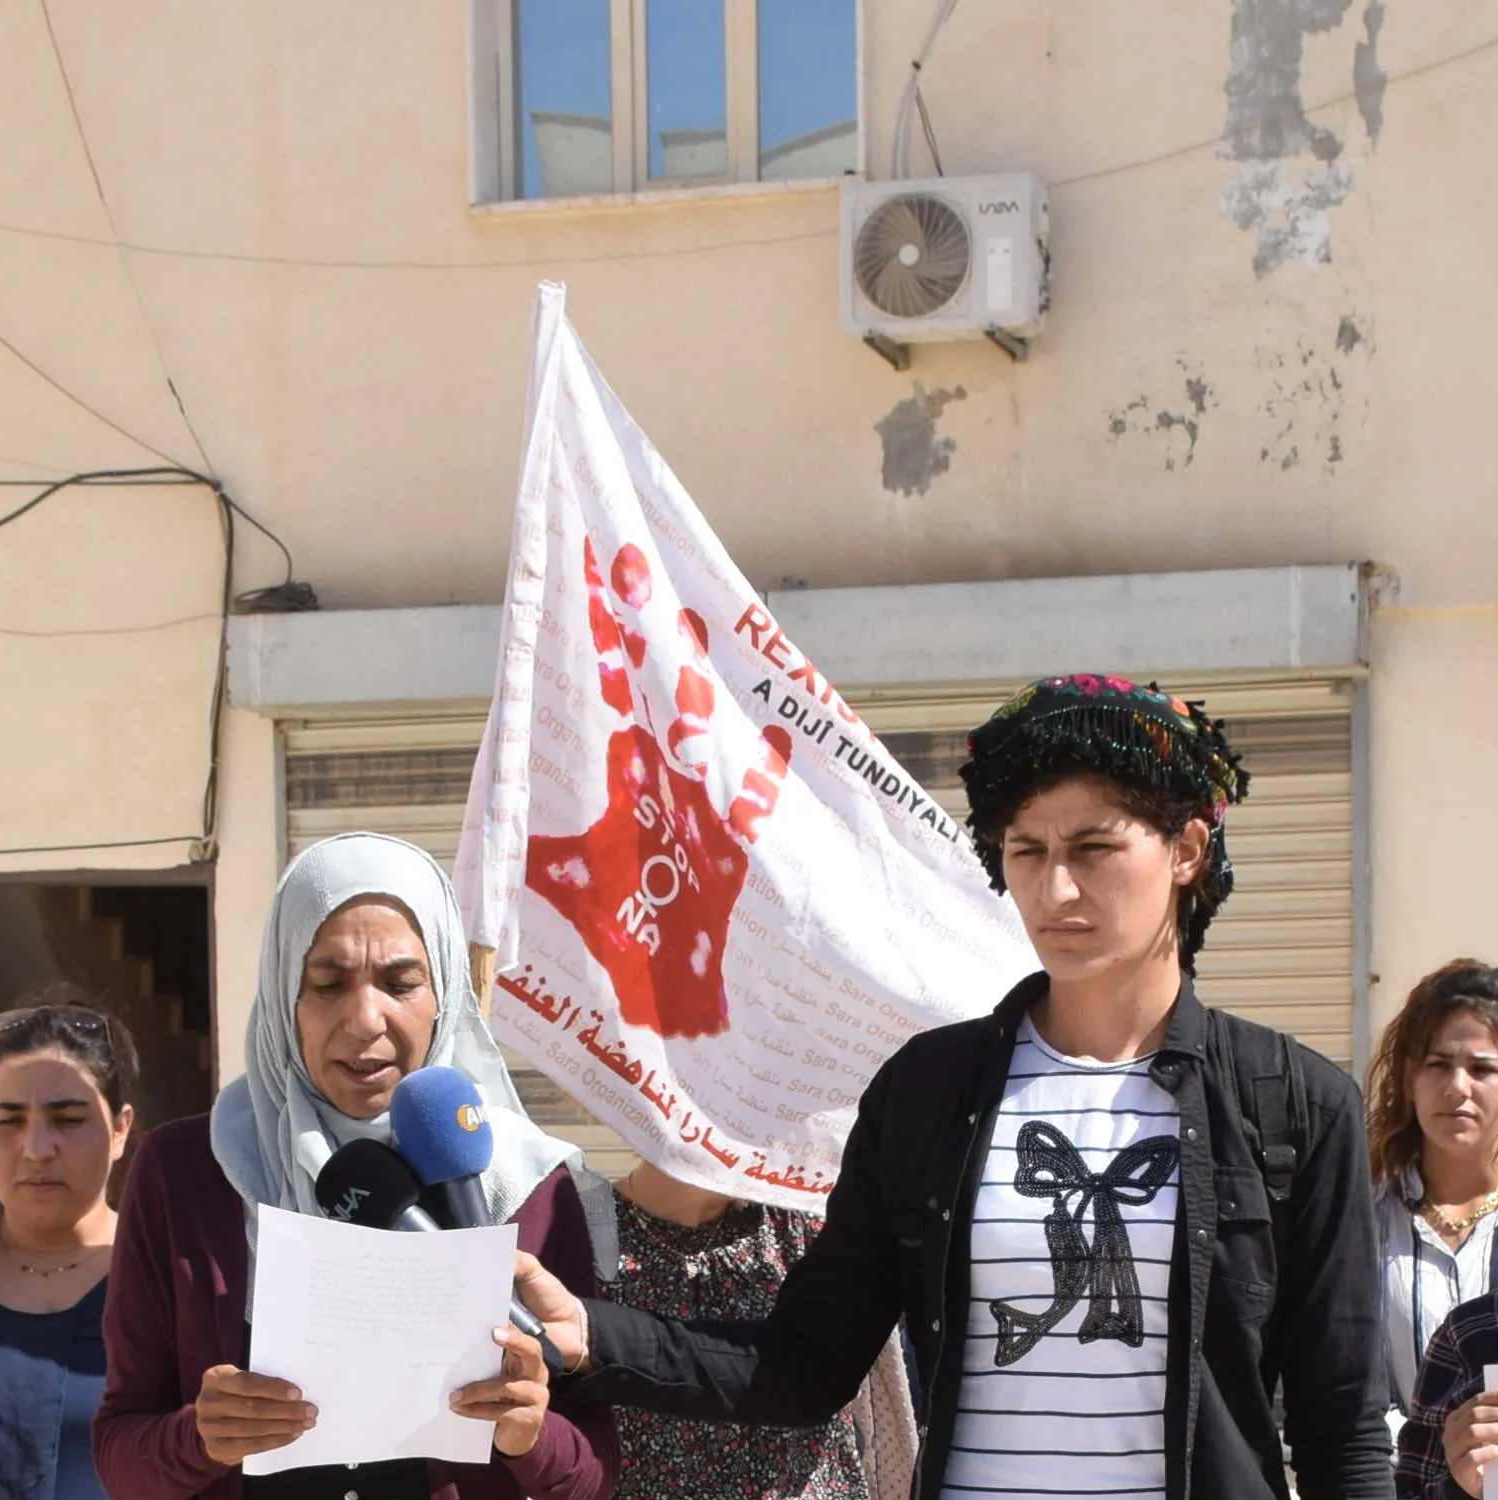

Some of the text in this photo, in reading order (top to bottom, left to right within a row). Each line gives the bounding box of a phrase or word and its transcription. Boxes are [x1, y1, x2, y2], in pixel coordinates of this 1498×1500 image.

[752, 678, 772, 703] A
[778, 696, 834, 744] DIJÎ
[835, 735, 961, 843] TUNDIYALI
[839, 978, 875, 1009] Sara
[824, 1002, 861, 1030] Sara
[801, 1049, 838, 1071] Sara
[547, 1040, 581, 1075] Sara
[582, 1067, 668, 1146] Organization
[786, 1078, 822, 1099] Sara
[774, 1102, 809, 1124] Sara
[679, 1112, 741, 1169] سارا
